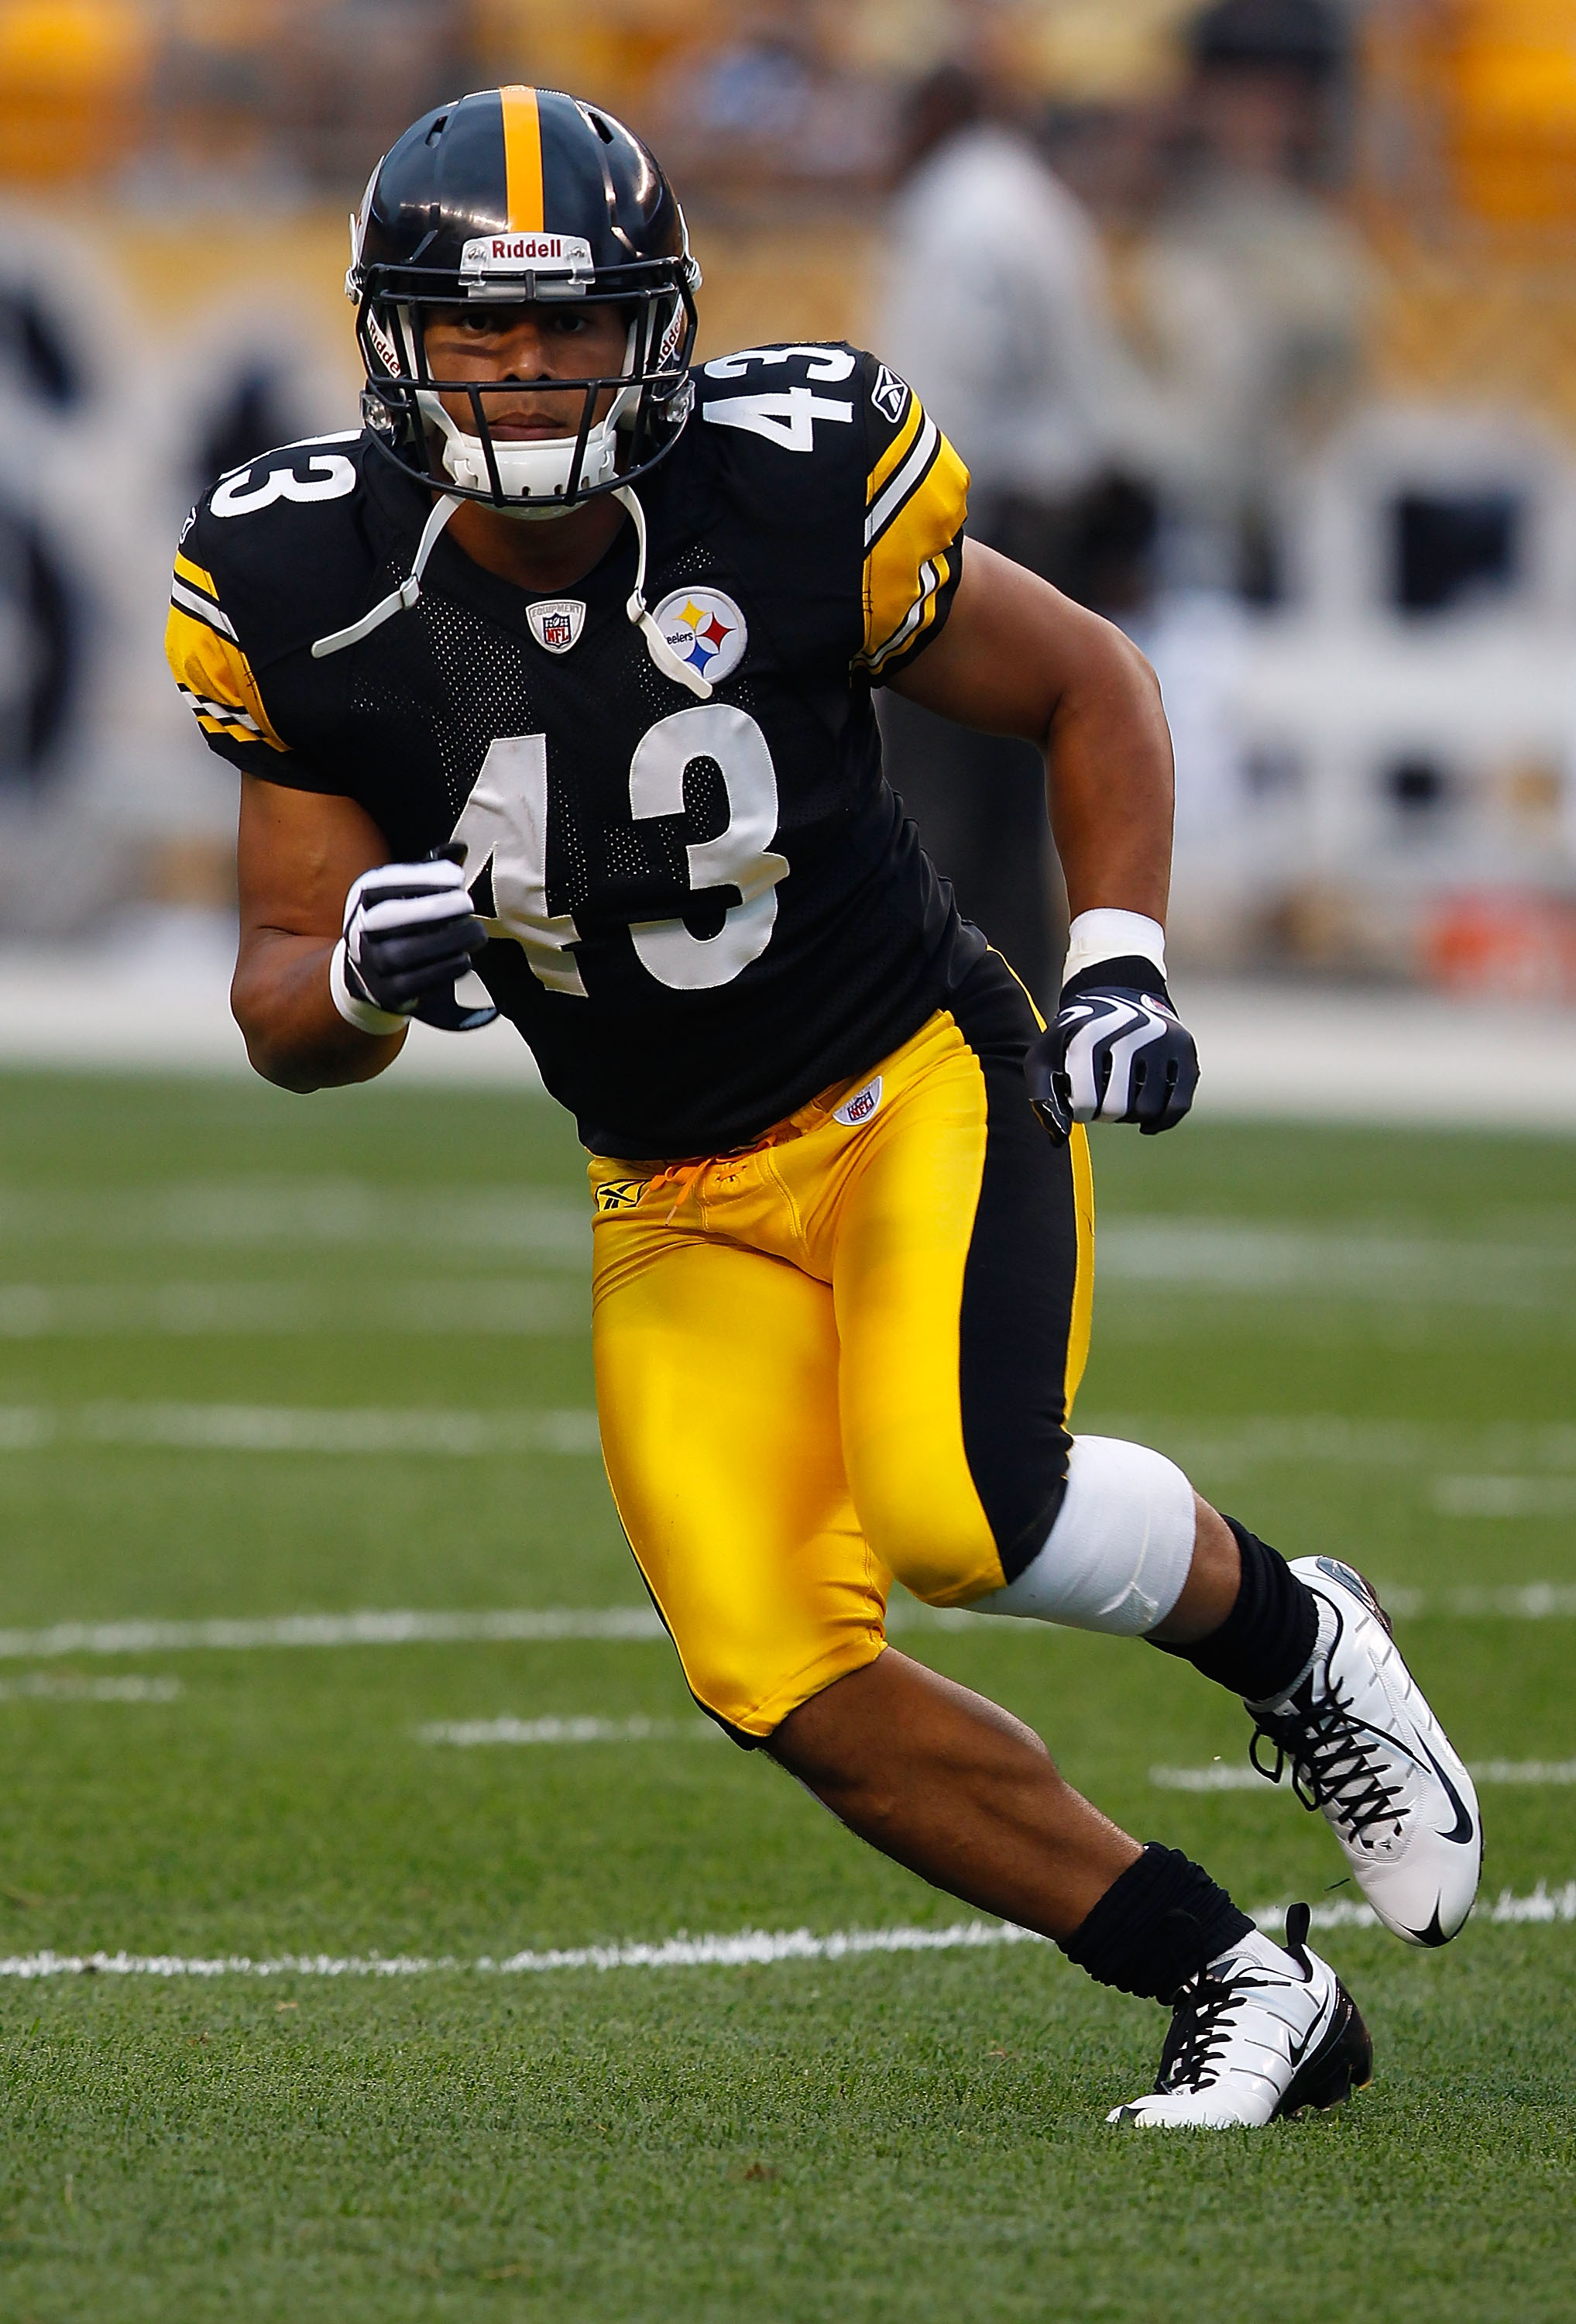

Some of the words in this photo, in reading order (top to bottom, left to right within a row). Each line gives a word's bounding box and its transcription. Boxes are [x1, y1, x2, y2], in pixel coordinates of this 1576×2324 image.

[493, 239, 561, 258] Riddell
[369, 320, 402, 378] Ridde
[702, 346, 856, 452] 43
[209, 428, 365, 518] 3
[531, 603, 580, 617] EQUIPMENT
[545, 627, 569, 644] NFL
[666, 632, 694, 645] eelers
[448, 703, 791, 998] 43
[850, 1099, 874, 1119] NFL
